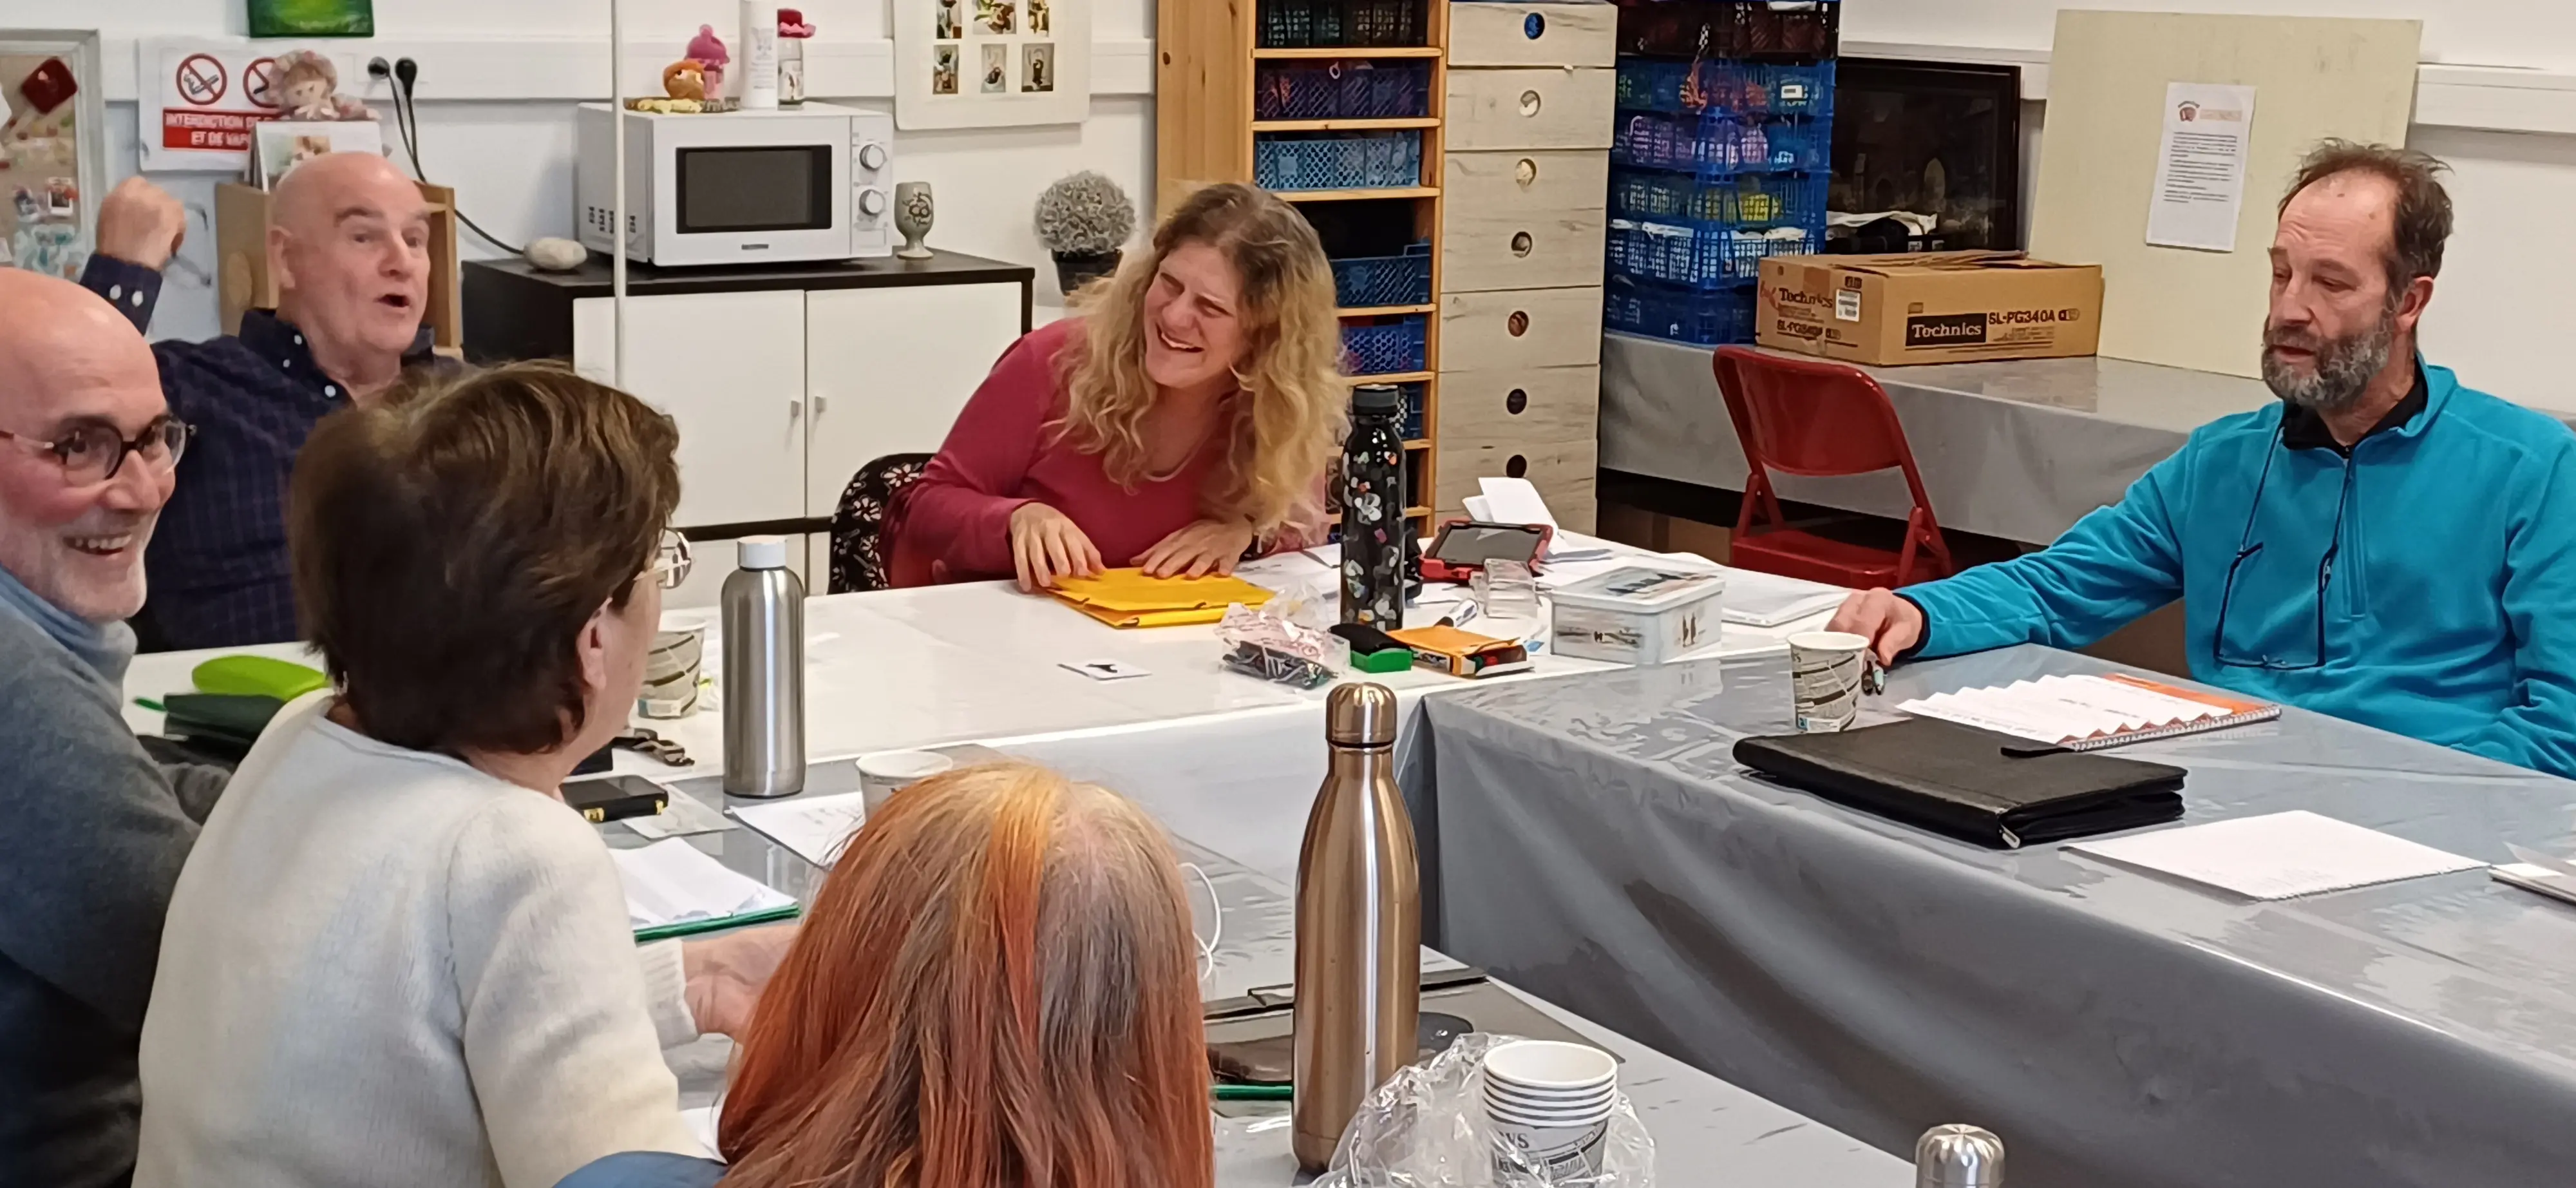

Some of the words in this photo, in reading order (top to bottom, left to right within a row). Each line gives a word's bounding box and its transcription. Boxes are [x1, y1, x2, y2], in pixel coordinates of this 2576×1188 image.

[166, 113, 244, 129] INTERDICTION
[191, 131, 207, 146] ET
[208, 131, 223, 147] DE
[226, 133, 249, 148] VAP
[1779, 287, 1833, 309] Technics
[1988, 309, 2056, 325] SL-PG340A
[1911, 322, 1982, 338] Technics
